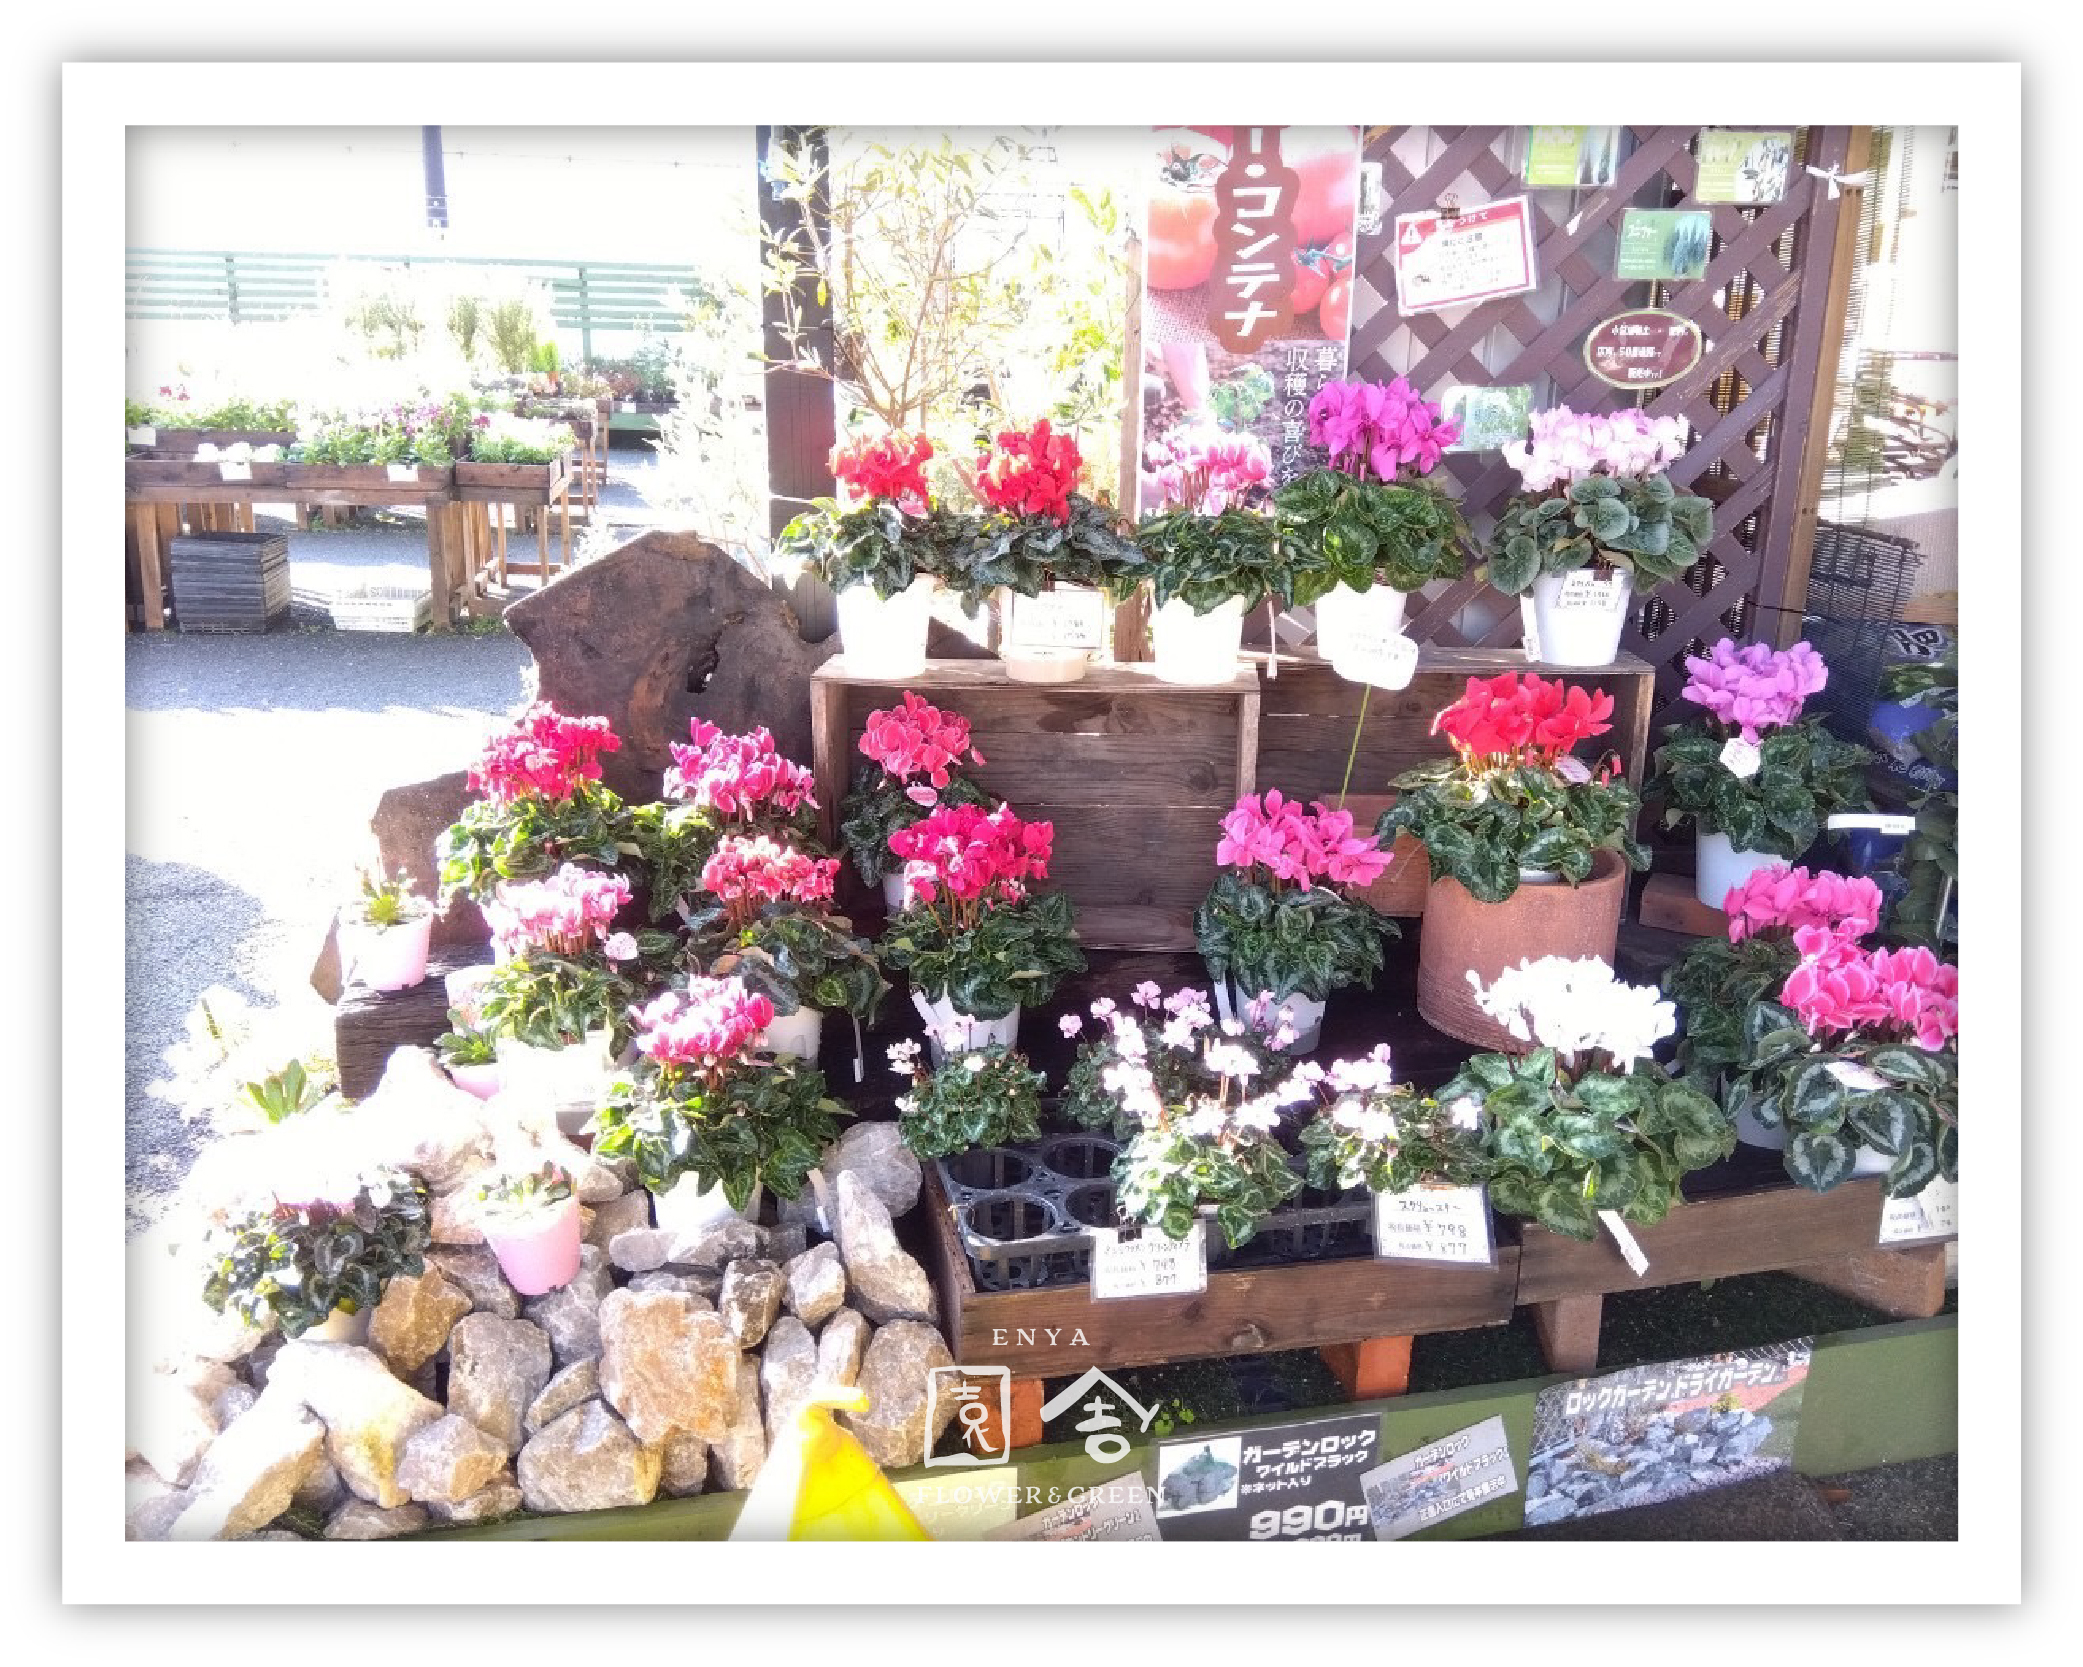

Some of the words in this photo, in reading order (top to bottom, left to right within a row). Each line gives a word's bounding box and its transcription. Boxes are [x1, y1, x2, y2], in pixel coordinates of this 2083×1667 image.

[1243, 1430, 1377, 1465] ガーデンロック
[1256, 1450, 1370, 1478] ワイルドブラック
[1249, 1500, 1368, 1540] 990円
